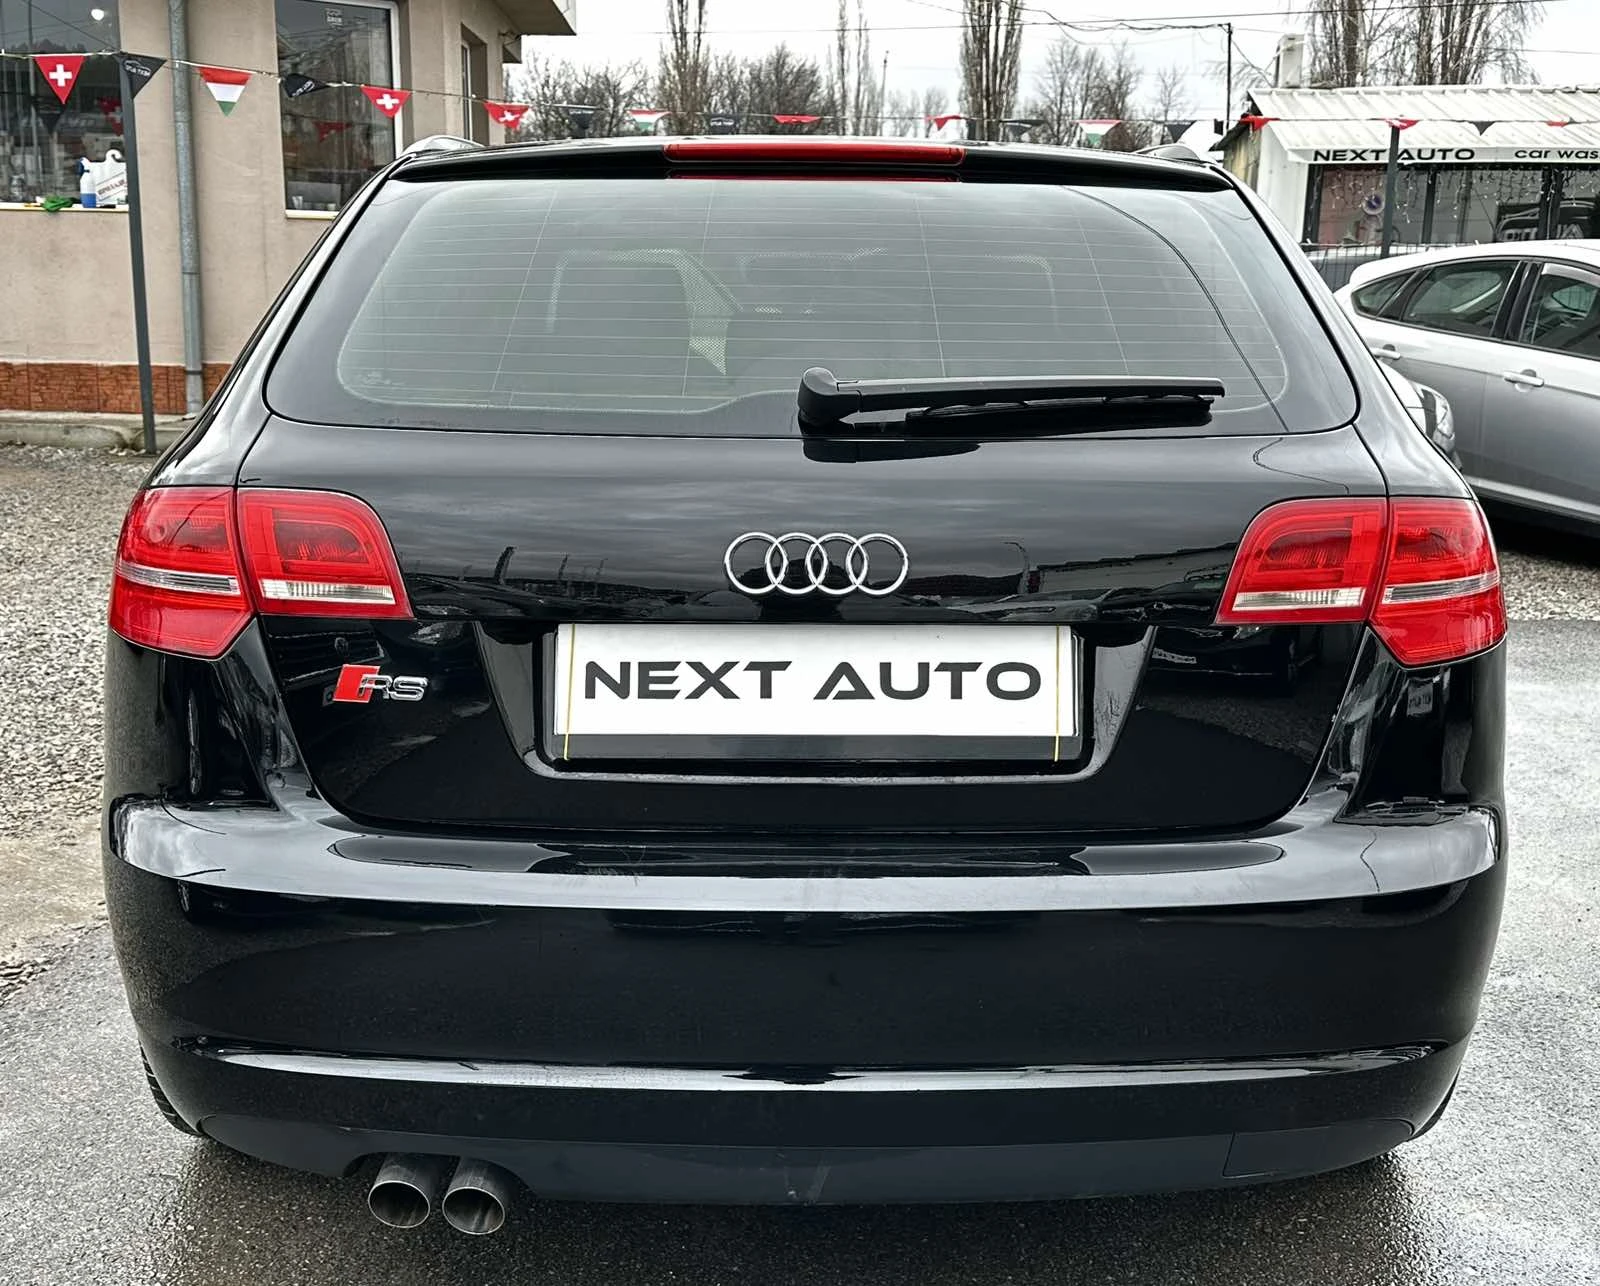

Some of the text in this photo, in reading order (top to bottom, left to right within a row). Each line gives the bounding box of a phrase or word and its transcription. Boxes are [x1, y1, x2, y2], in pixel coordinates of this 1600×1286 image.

[1313, 148, 1475, 162] NEXT AUTO
[1514, 149, 1551, 159] car
[357, 673, 429, 701] RS
[584, 660, 1042, 701] NEXT AUTO
